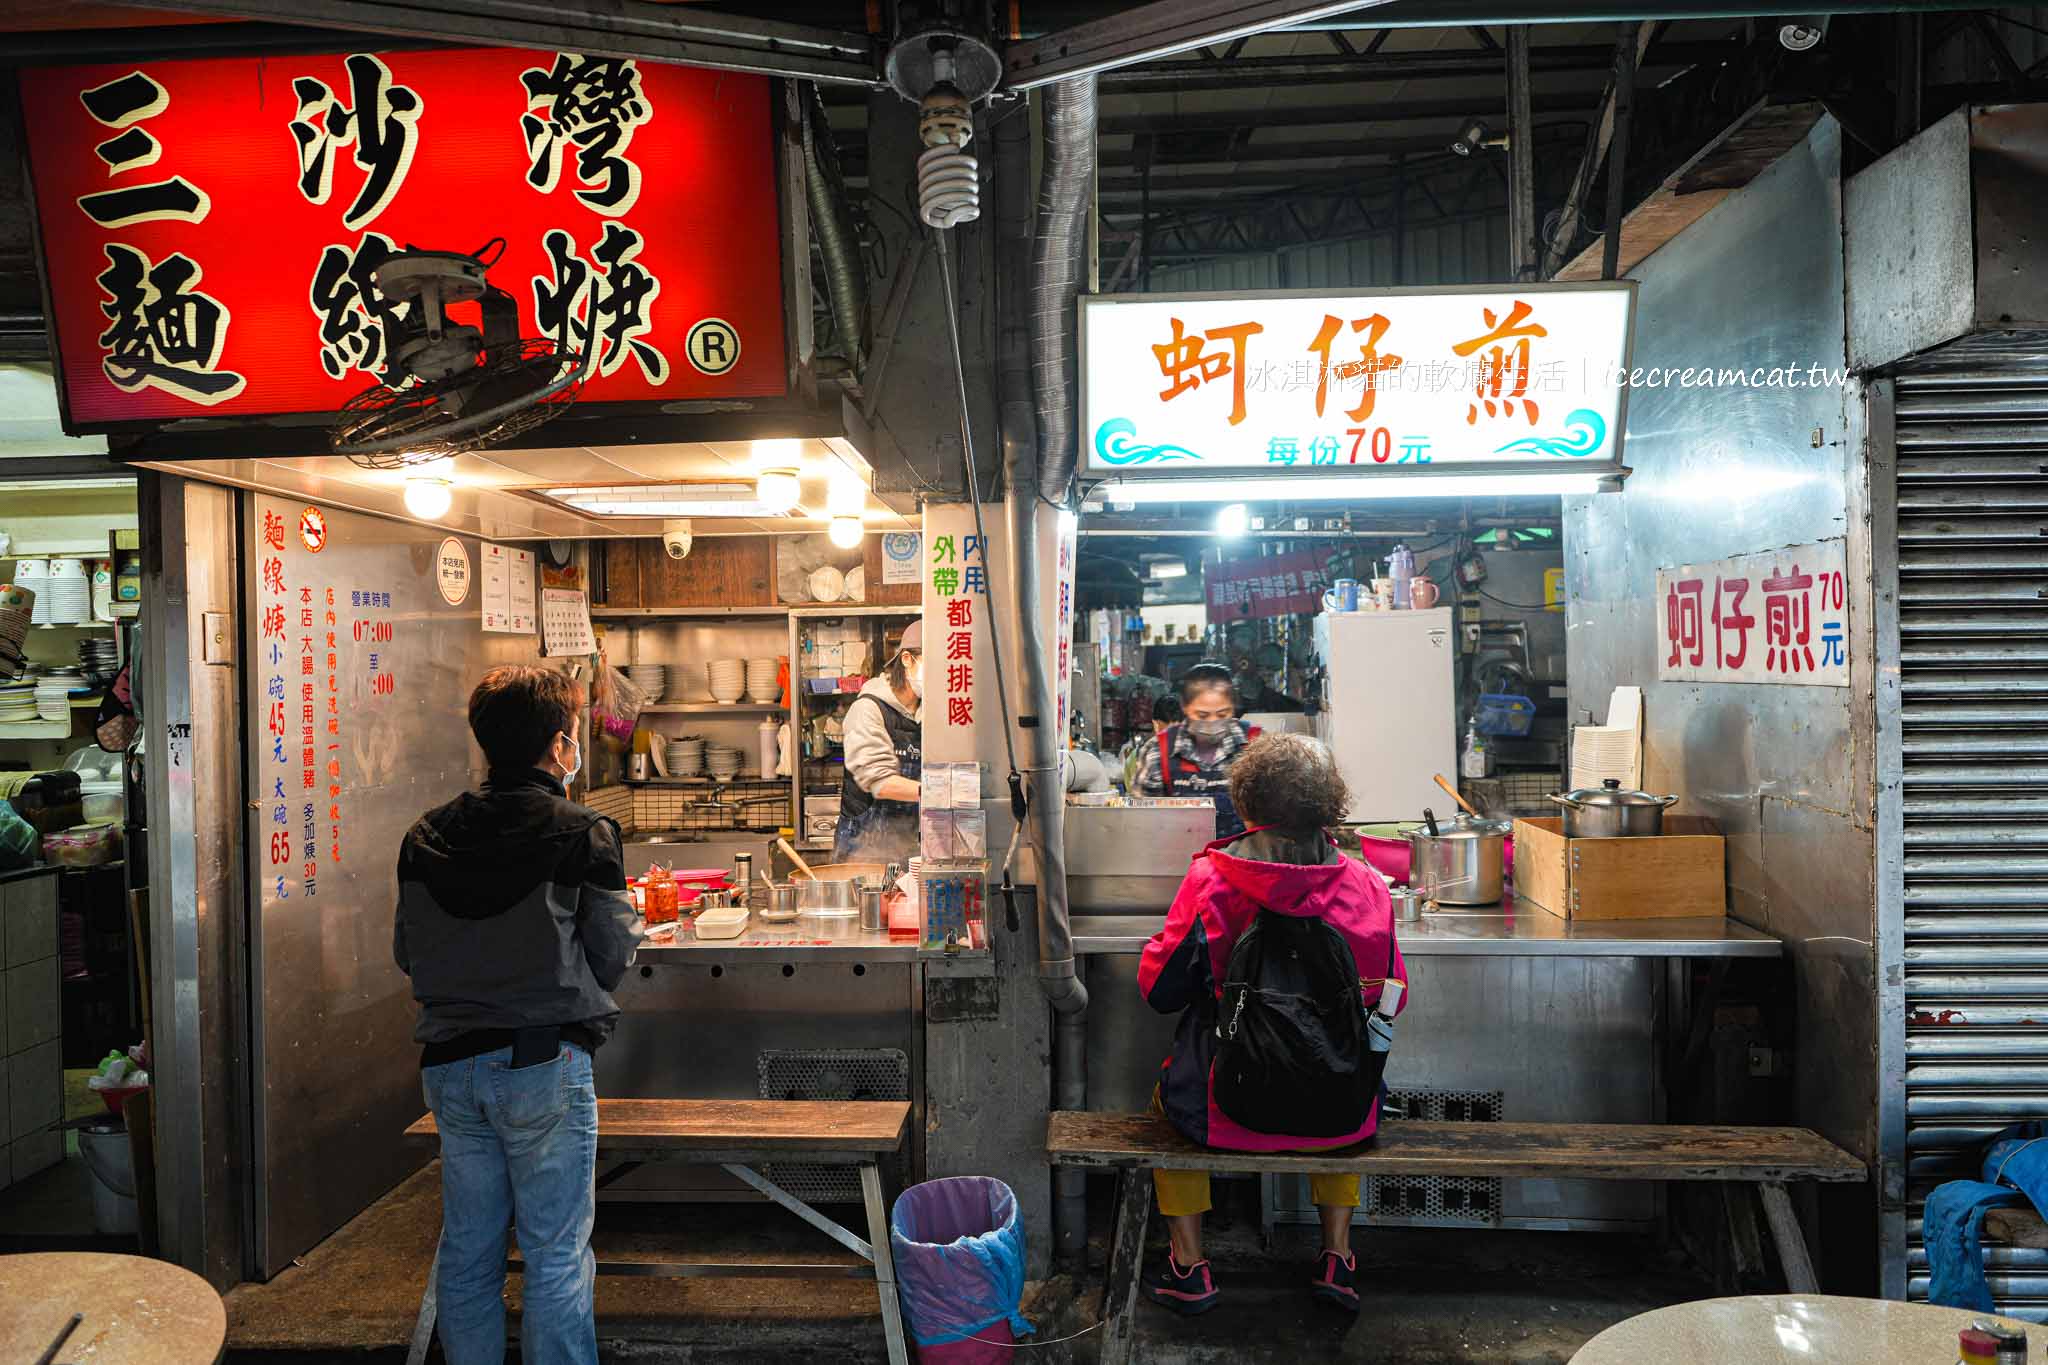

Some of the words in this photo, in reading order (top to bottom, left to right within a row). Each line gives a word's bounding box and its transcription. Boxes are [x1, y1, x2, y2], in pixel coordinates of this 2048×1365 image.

[78, 54, 654, 232] 三沙灣
[1151, 300, 1549, 427] 蚵仔煎
[1266, 426, 1432, 466] 每份70元
[932, 535, 960, 597] 外帶
[962, 535, 988, 595] 內用
[353, 619, 393, 642] 07:00
[1667, 564, 1815, 673] 蚵仔煎
[369, 653, 379, 671] 至
[946, 599, 974, 727] 都須排隊
